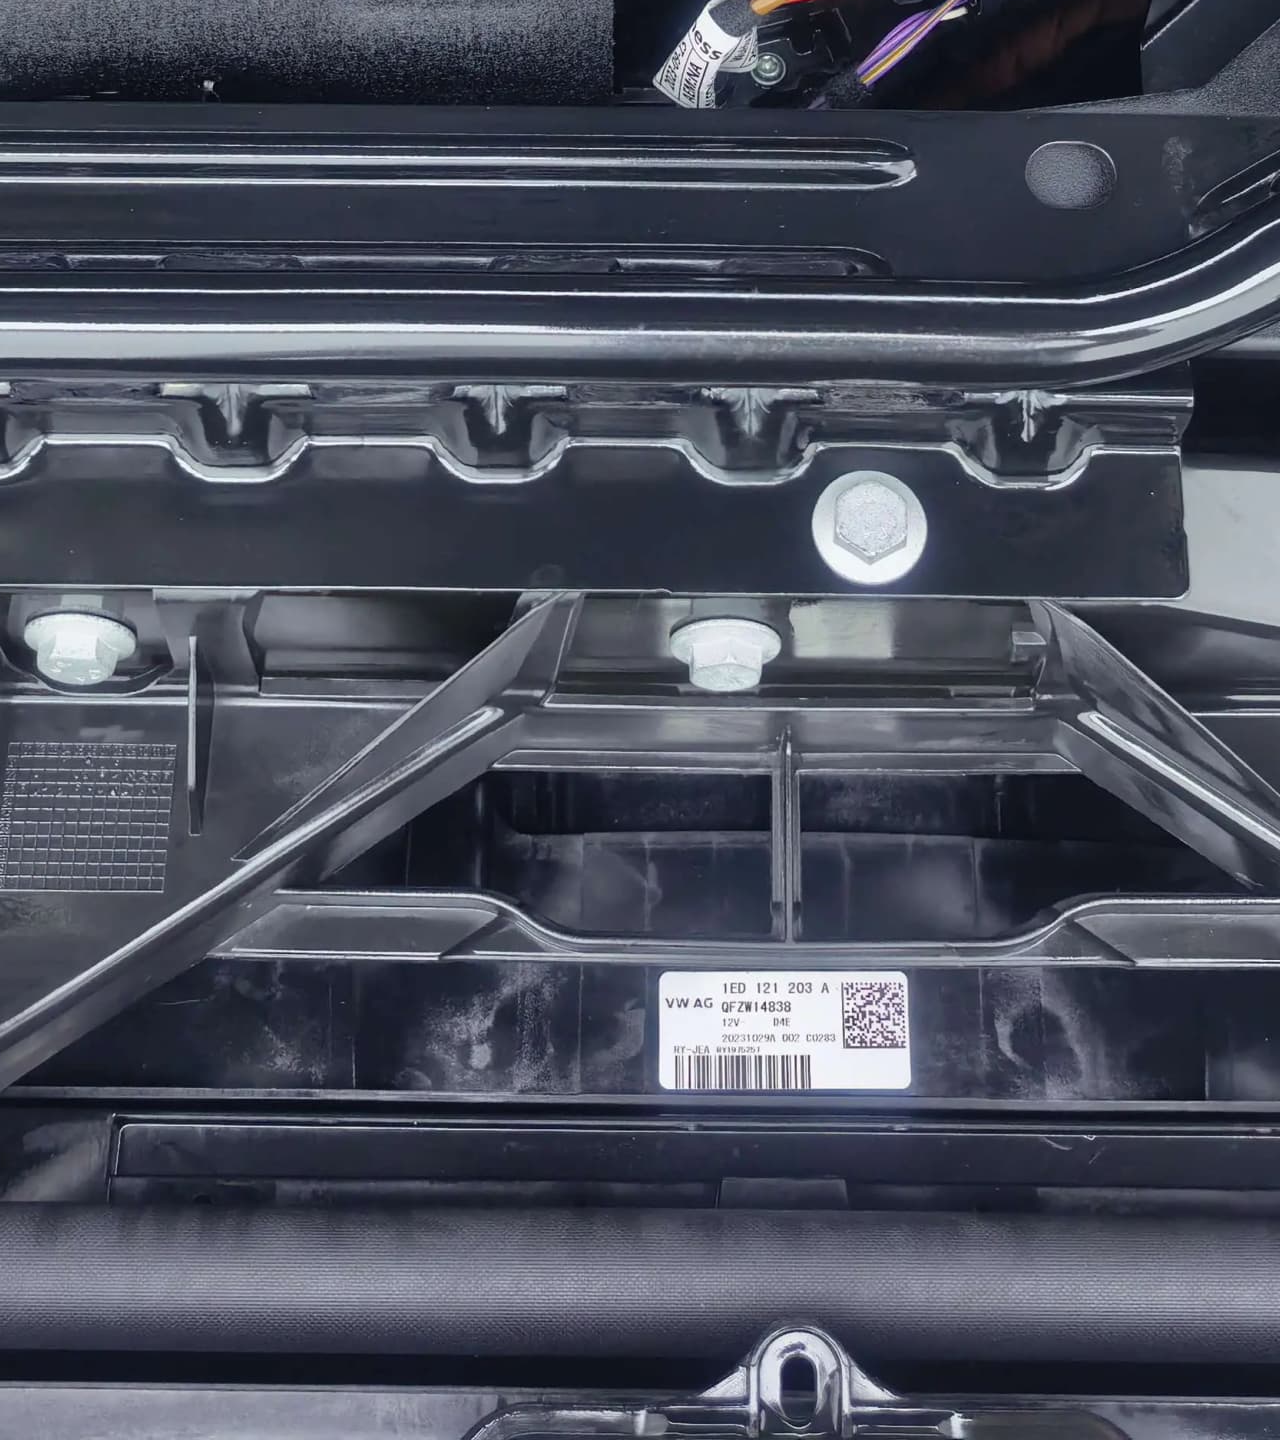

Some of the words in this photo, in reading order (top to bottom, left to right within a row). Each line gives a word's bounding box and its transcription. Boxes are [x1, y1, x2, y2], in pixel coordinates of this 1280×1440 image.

[692, 25, 722, 61] ess
[722, 982, 747, 994] 1ED
[756, 982, 779, 994] 121
[788, 982, 813, 994] 203
[820, 982, 830, 994] A
[665, 997, 690, 1009] VW
[692, 997, 714, 1009] AG
[722, 1017, 740, 1027] 12V
